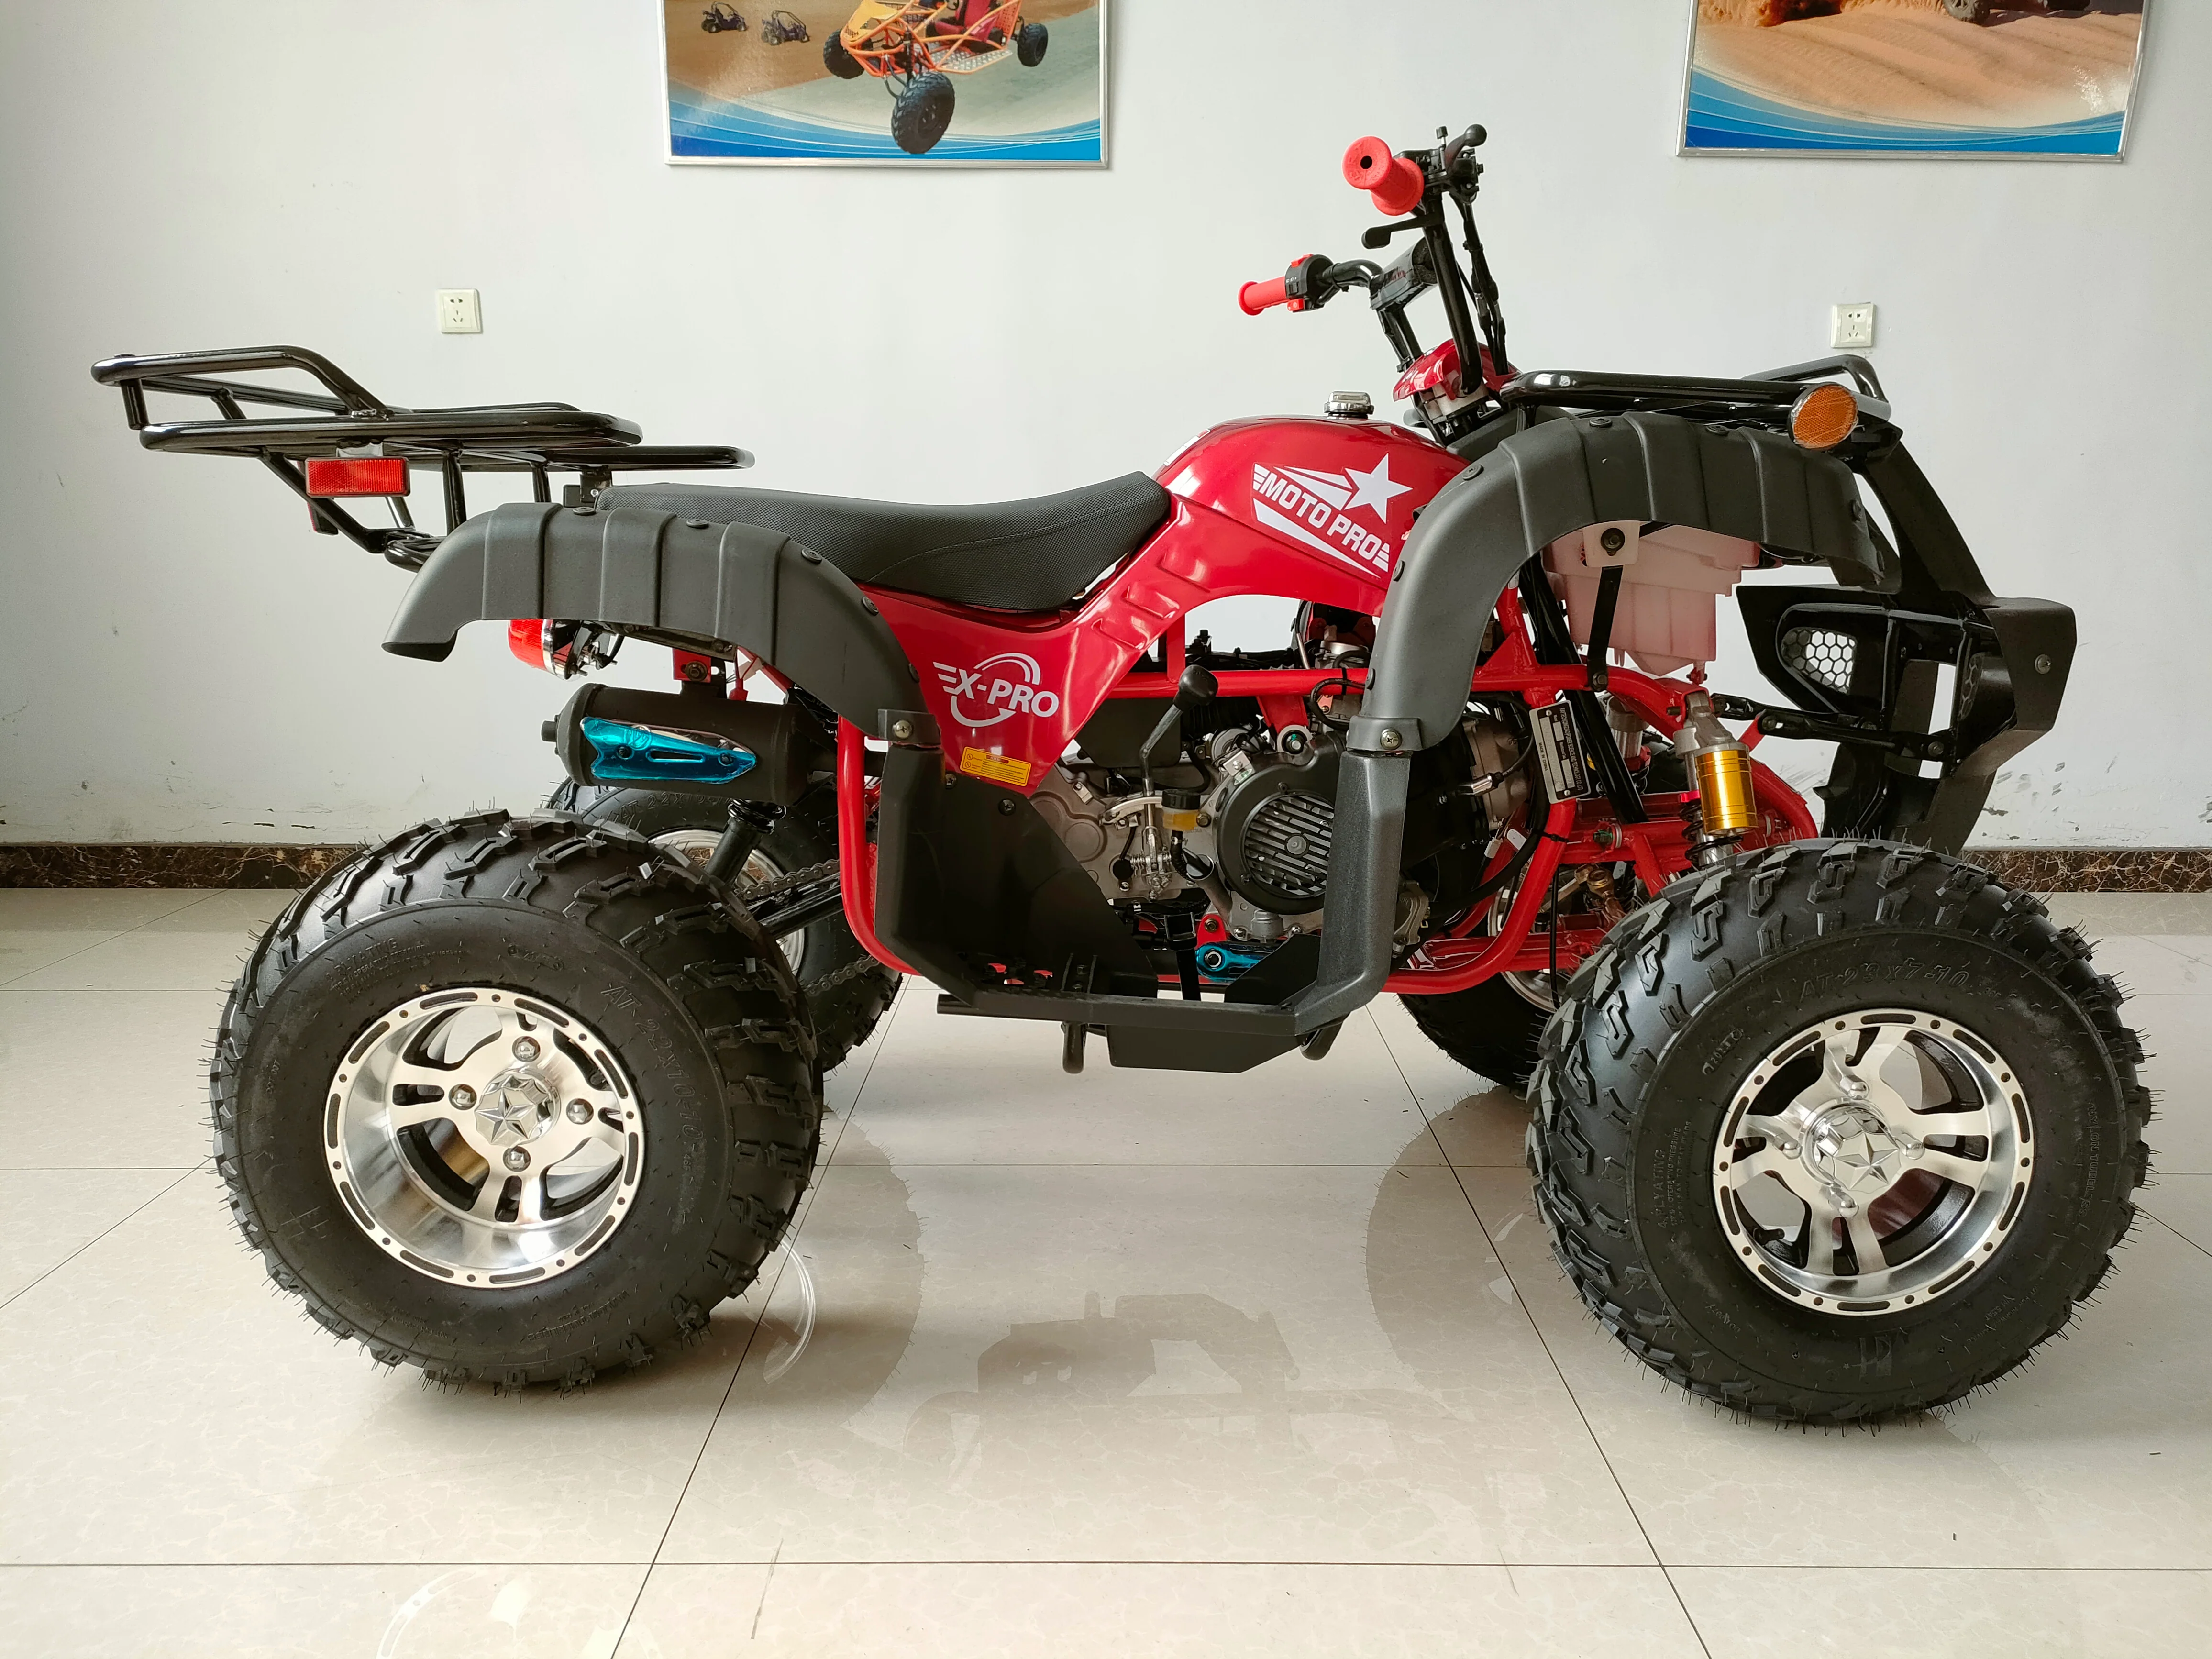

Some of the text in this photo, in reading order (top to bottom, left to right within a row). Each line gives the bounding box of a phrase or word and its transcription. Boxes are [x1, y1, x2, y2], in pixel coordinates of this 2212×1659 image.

[1259, 472, 1383, 561] MOTO PRO
[951, 668, 1059, 718] X-PRO
